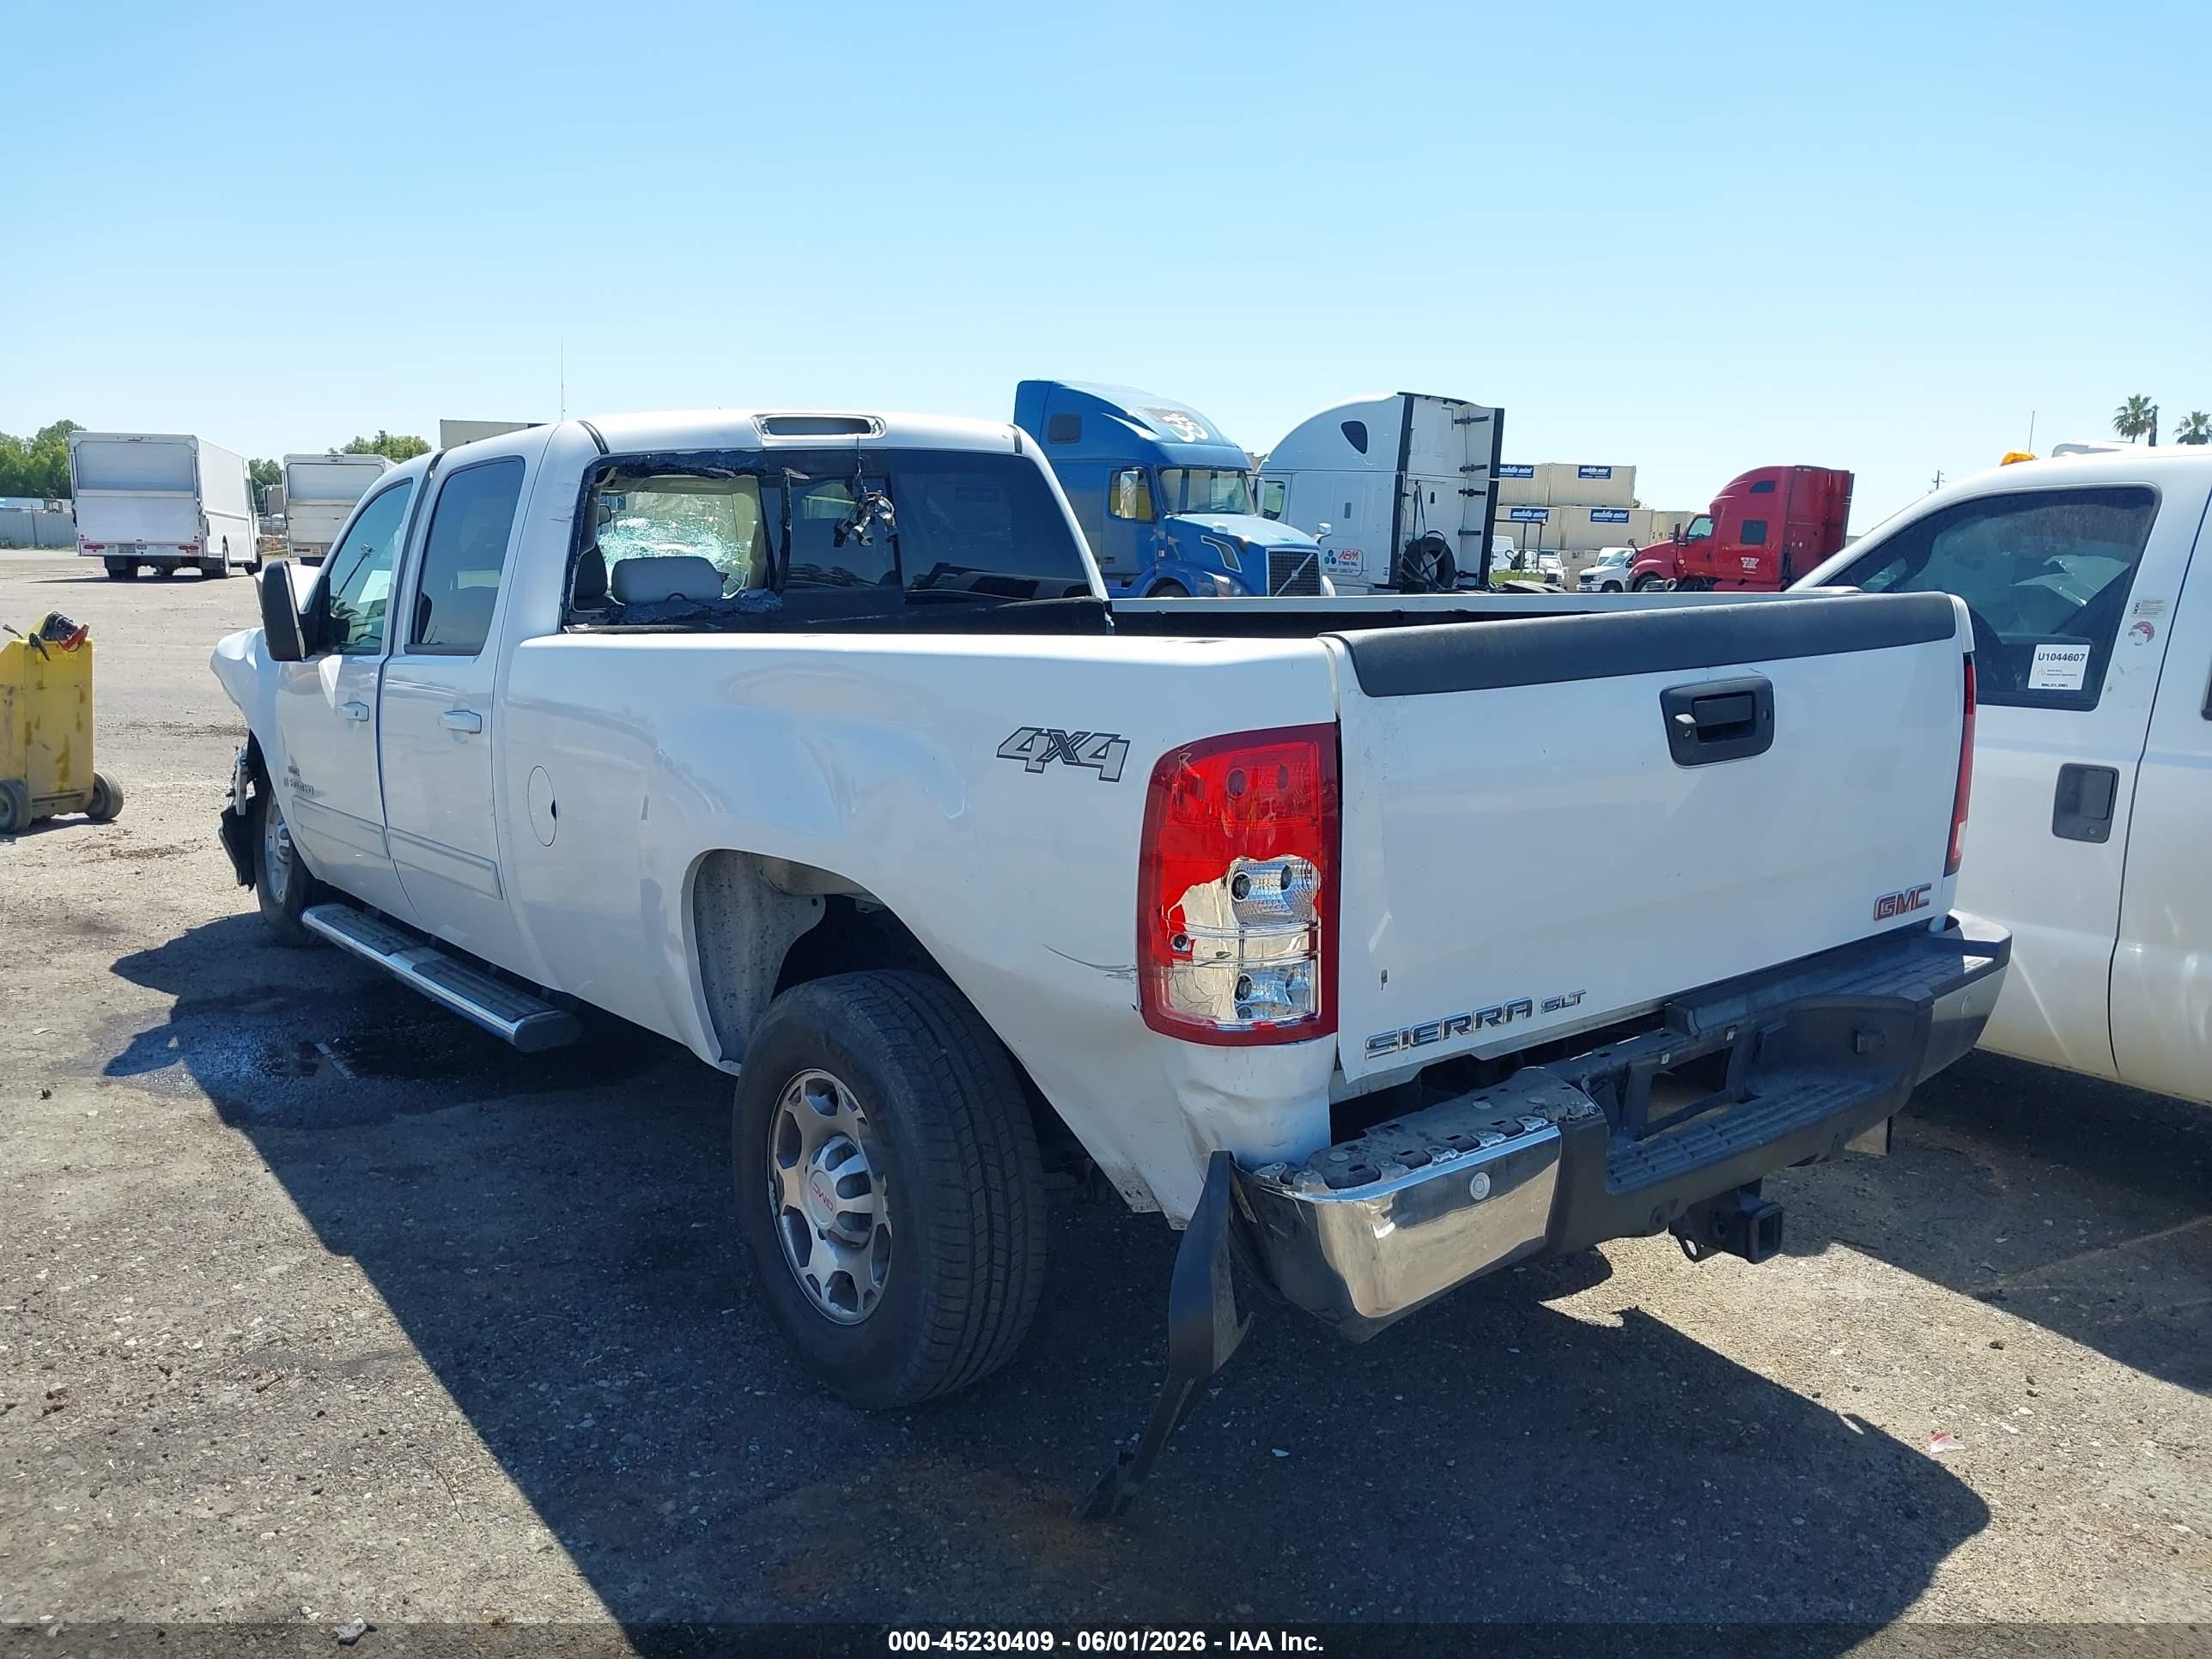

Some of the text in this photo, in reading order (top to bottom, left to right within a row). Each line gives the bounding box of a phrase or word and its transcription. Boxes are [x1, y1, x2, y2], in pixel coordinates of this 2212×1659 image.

[2038, 652, 2086, 662] U1044607
[1874, 883, 1932, 921] GMC
[1364, 989, 1587, 1060] SIERRA SLT
[811, 1181, 834, 1212] GMC
